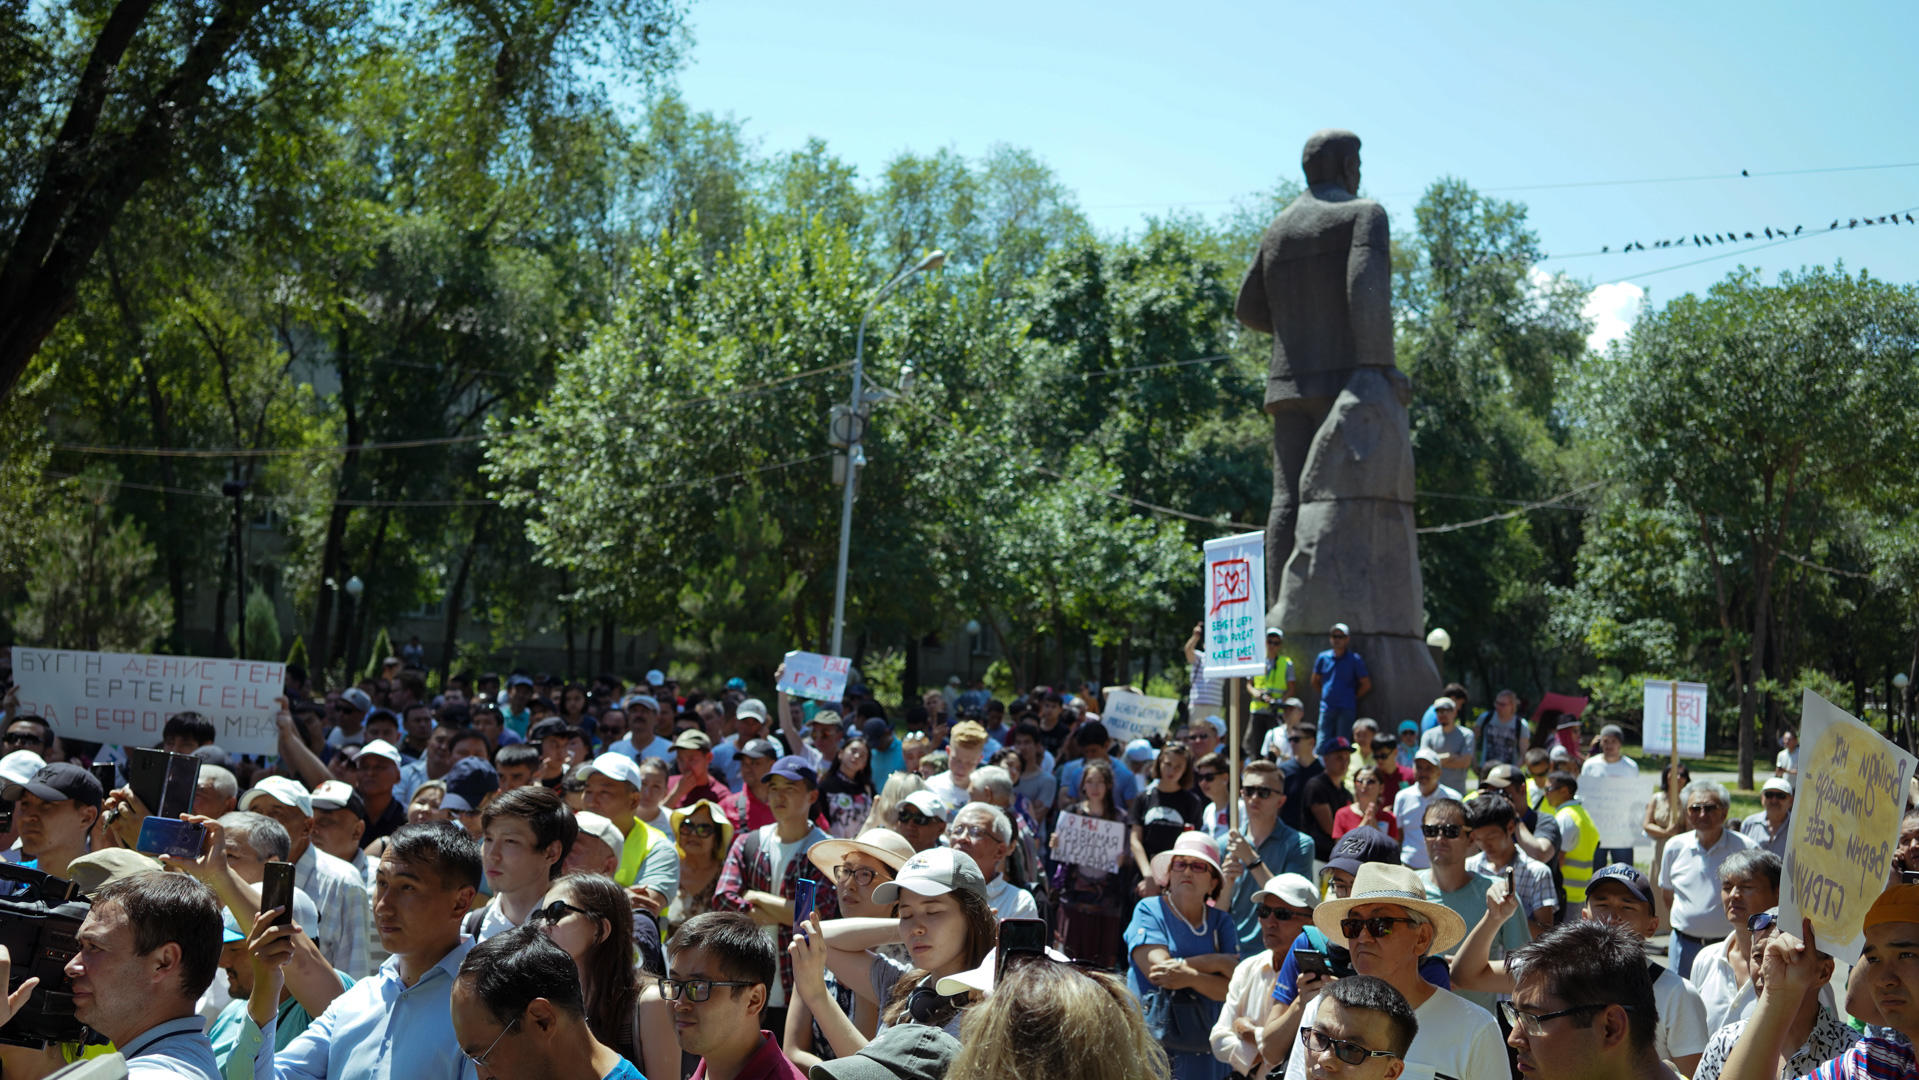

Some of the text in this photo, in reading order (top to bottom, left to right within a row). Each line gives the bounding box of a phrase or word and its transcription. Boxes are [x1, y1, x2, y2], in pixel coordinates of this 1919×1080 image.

[122, 658, 216, 680] ДЕНИС
[229, 662, 283, 684] ТЕН
[794, 672, 832, 690] ГАЗ
